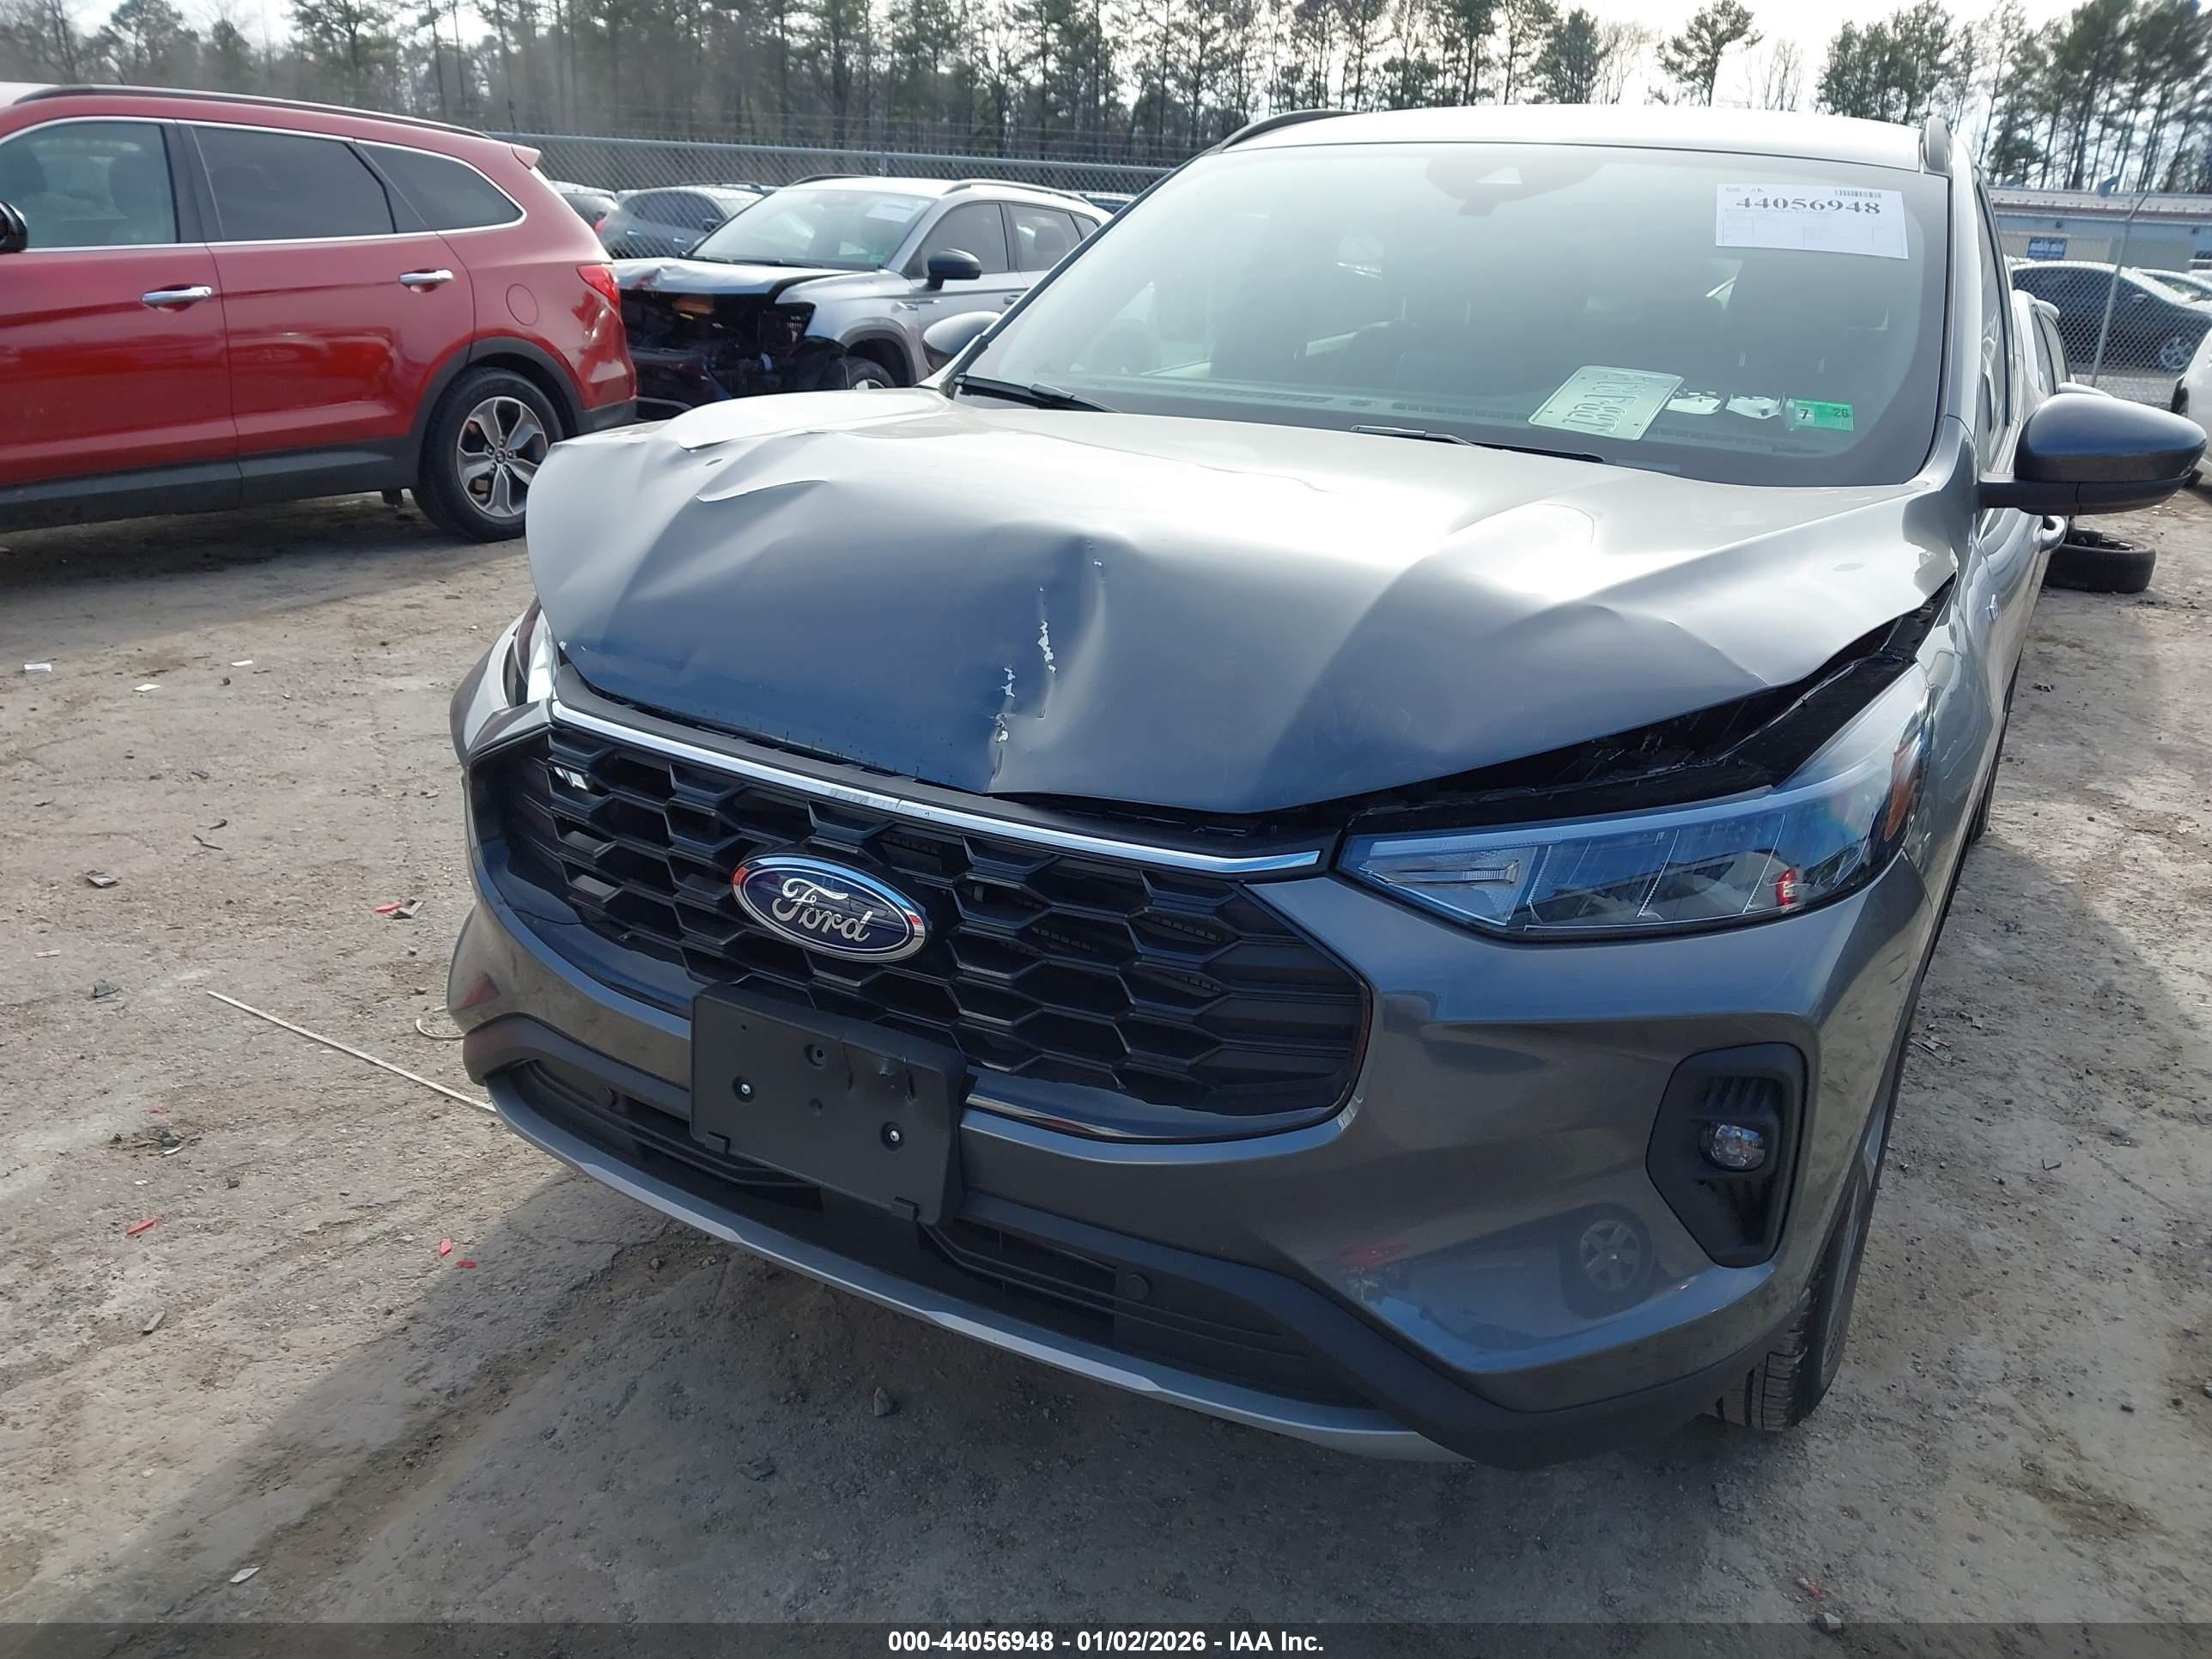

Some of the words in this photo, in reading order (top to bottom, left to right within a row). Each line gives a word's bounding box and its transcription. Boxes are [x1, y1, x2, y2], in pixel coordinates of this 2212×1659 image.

[1735, 197, 1881, 215] 44056948
[1800, 409, 1808, 419] 7
[1833, 408, 1849, 418] 26
[772, 878, 873, 941] Ford
